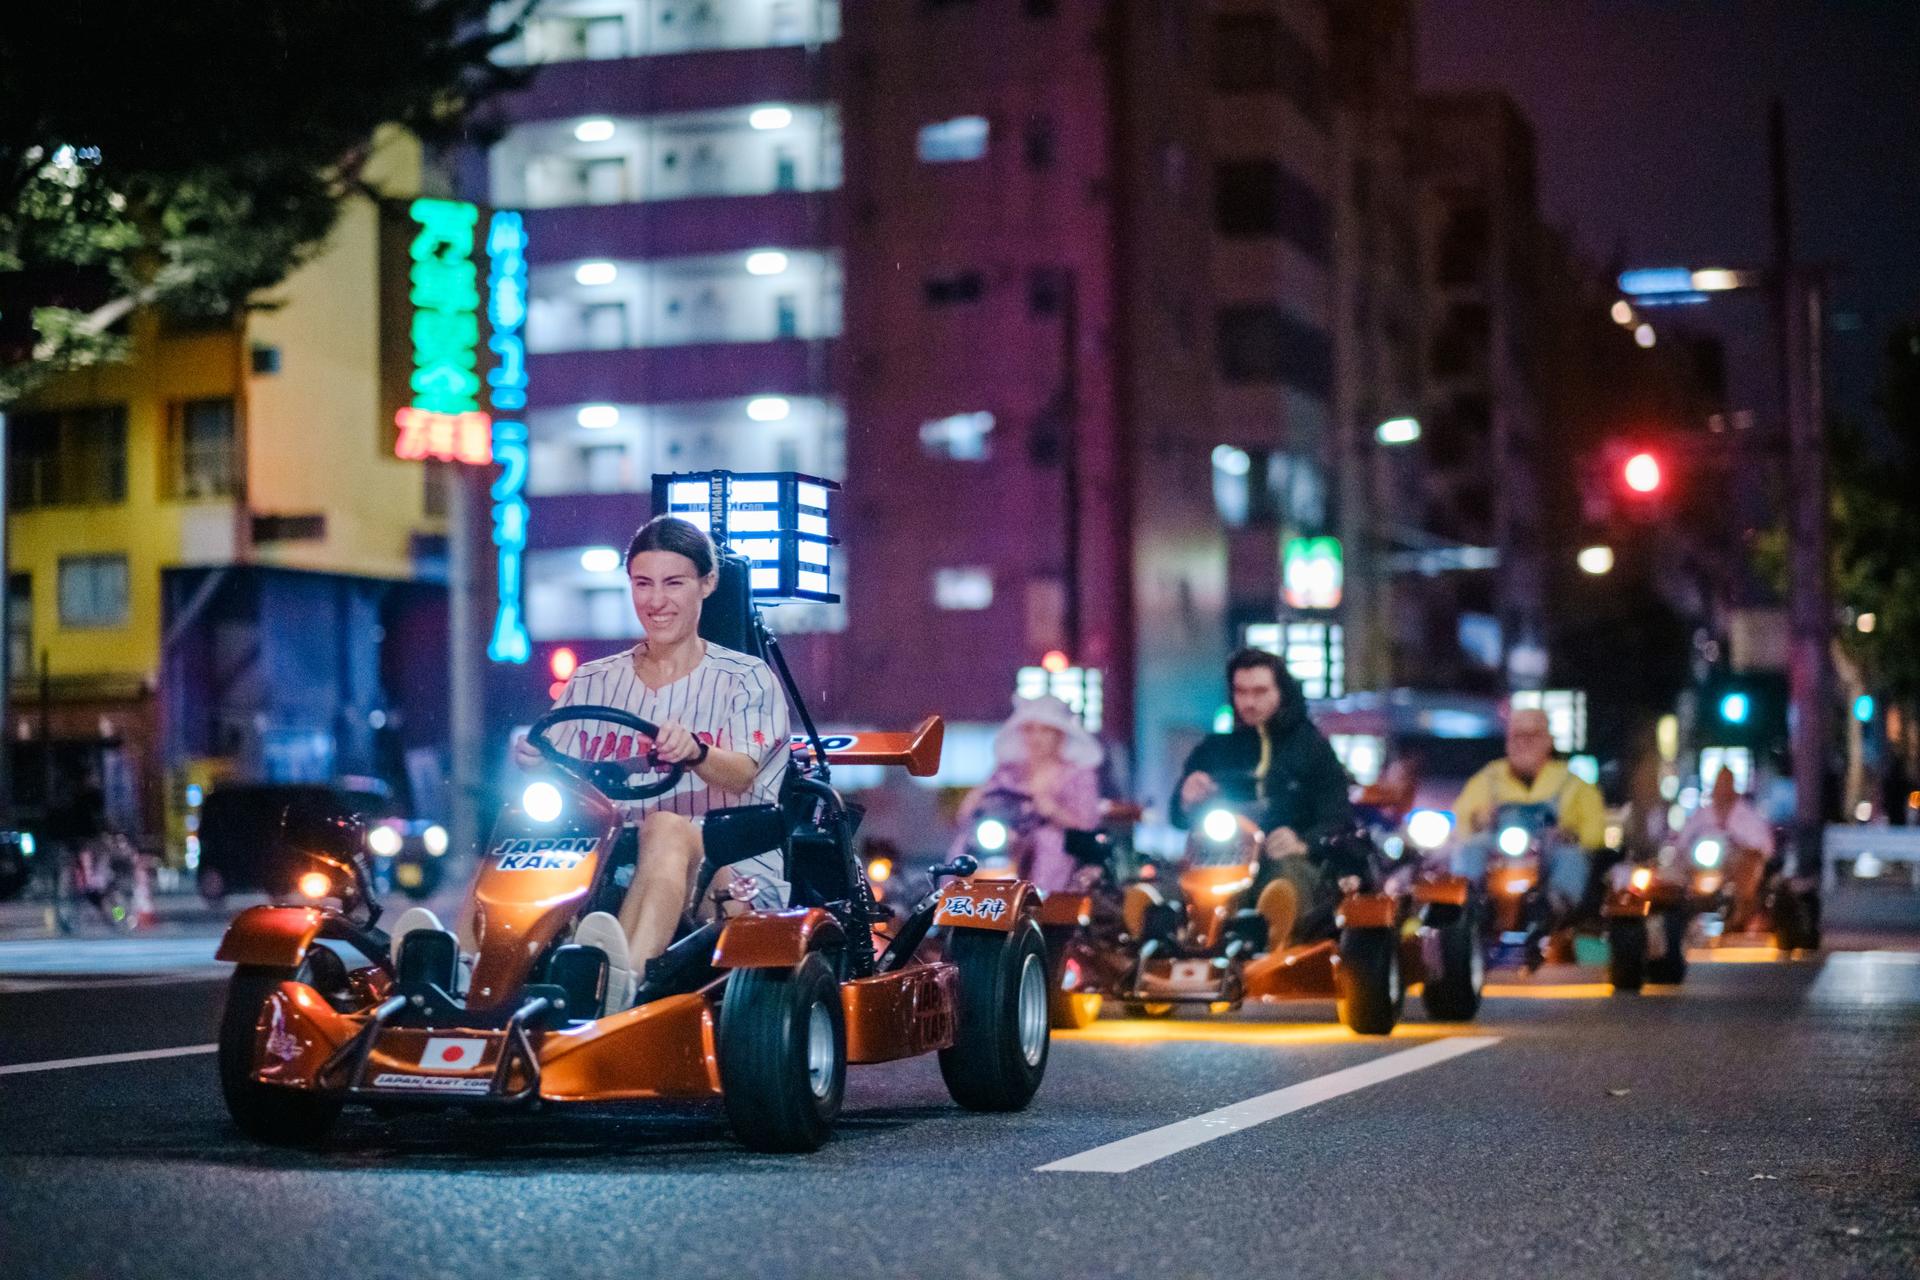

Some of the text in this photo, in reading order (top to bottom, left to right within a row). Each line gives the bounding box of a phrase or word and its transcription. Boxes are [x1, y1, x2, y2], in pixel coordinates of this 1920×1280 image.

[493, 838, 598, 855] JAPAN
[497, 854, 582, 871] KART
[379, 1075, 421, 1084] JAPAN
